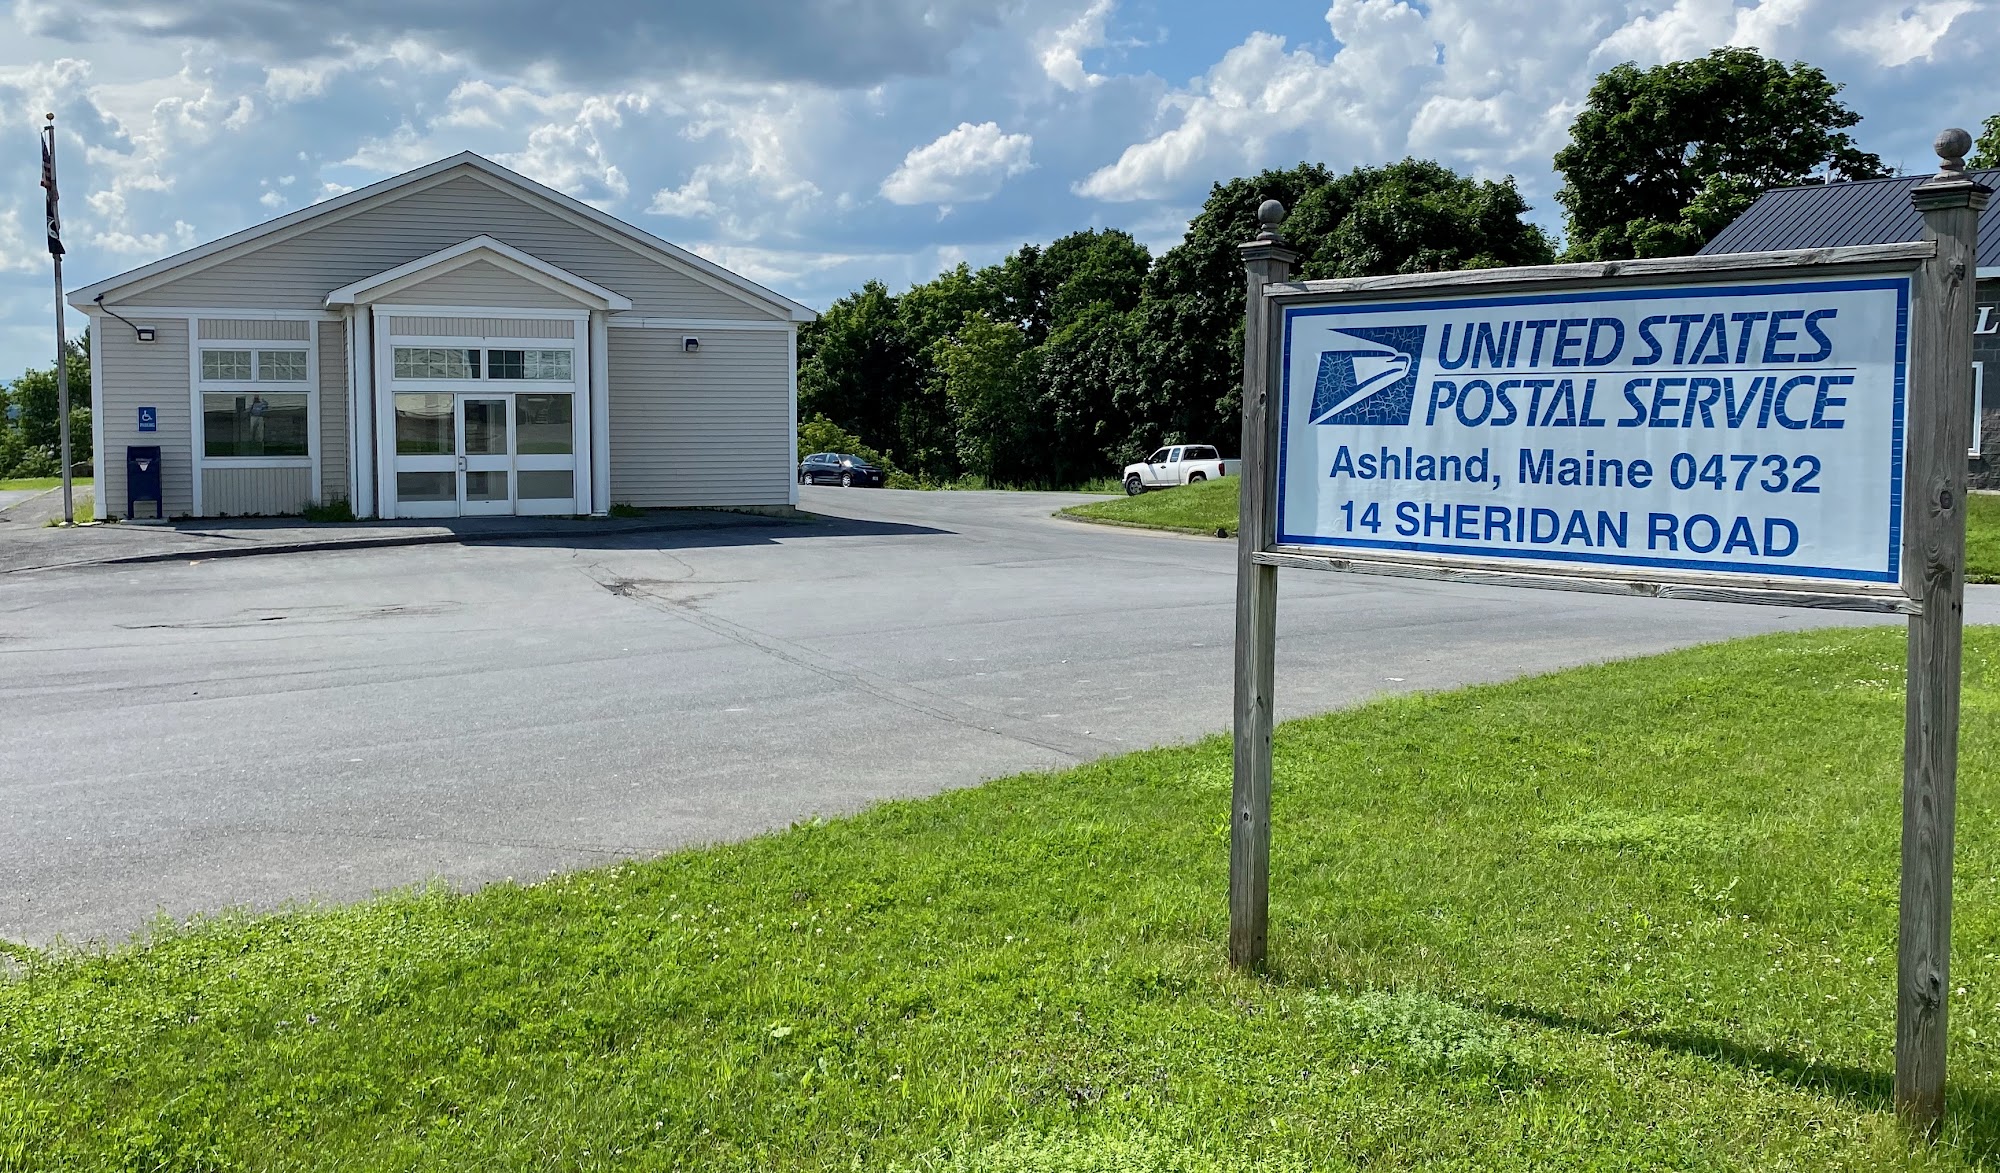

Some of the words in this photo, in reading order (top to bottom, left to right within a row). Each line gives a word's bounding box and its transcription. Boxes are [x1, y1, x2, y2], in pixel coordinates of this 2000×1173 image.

[1438, 314, 1626, 371] UNITED
[1631, 308, 1838, 366] STATES
[1425, 378, 1606, 429] POSTAL
[1616, 375, 1855, 431] SERVICE
[1329, 445, 1501, 491] Ashland,
[1518, 448, 1654, 489] Maine
[1670, 452, 1822, 494] 04732
[1341, 500, 1382, 534] 14
[1395, 501, 1629, 550] SHERIDAN
[1647, 512, 1800, 558] ROAD
